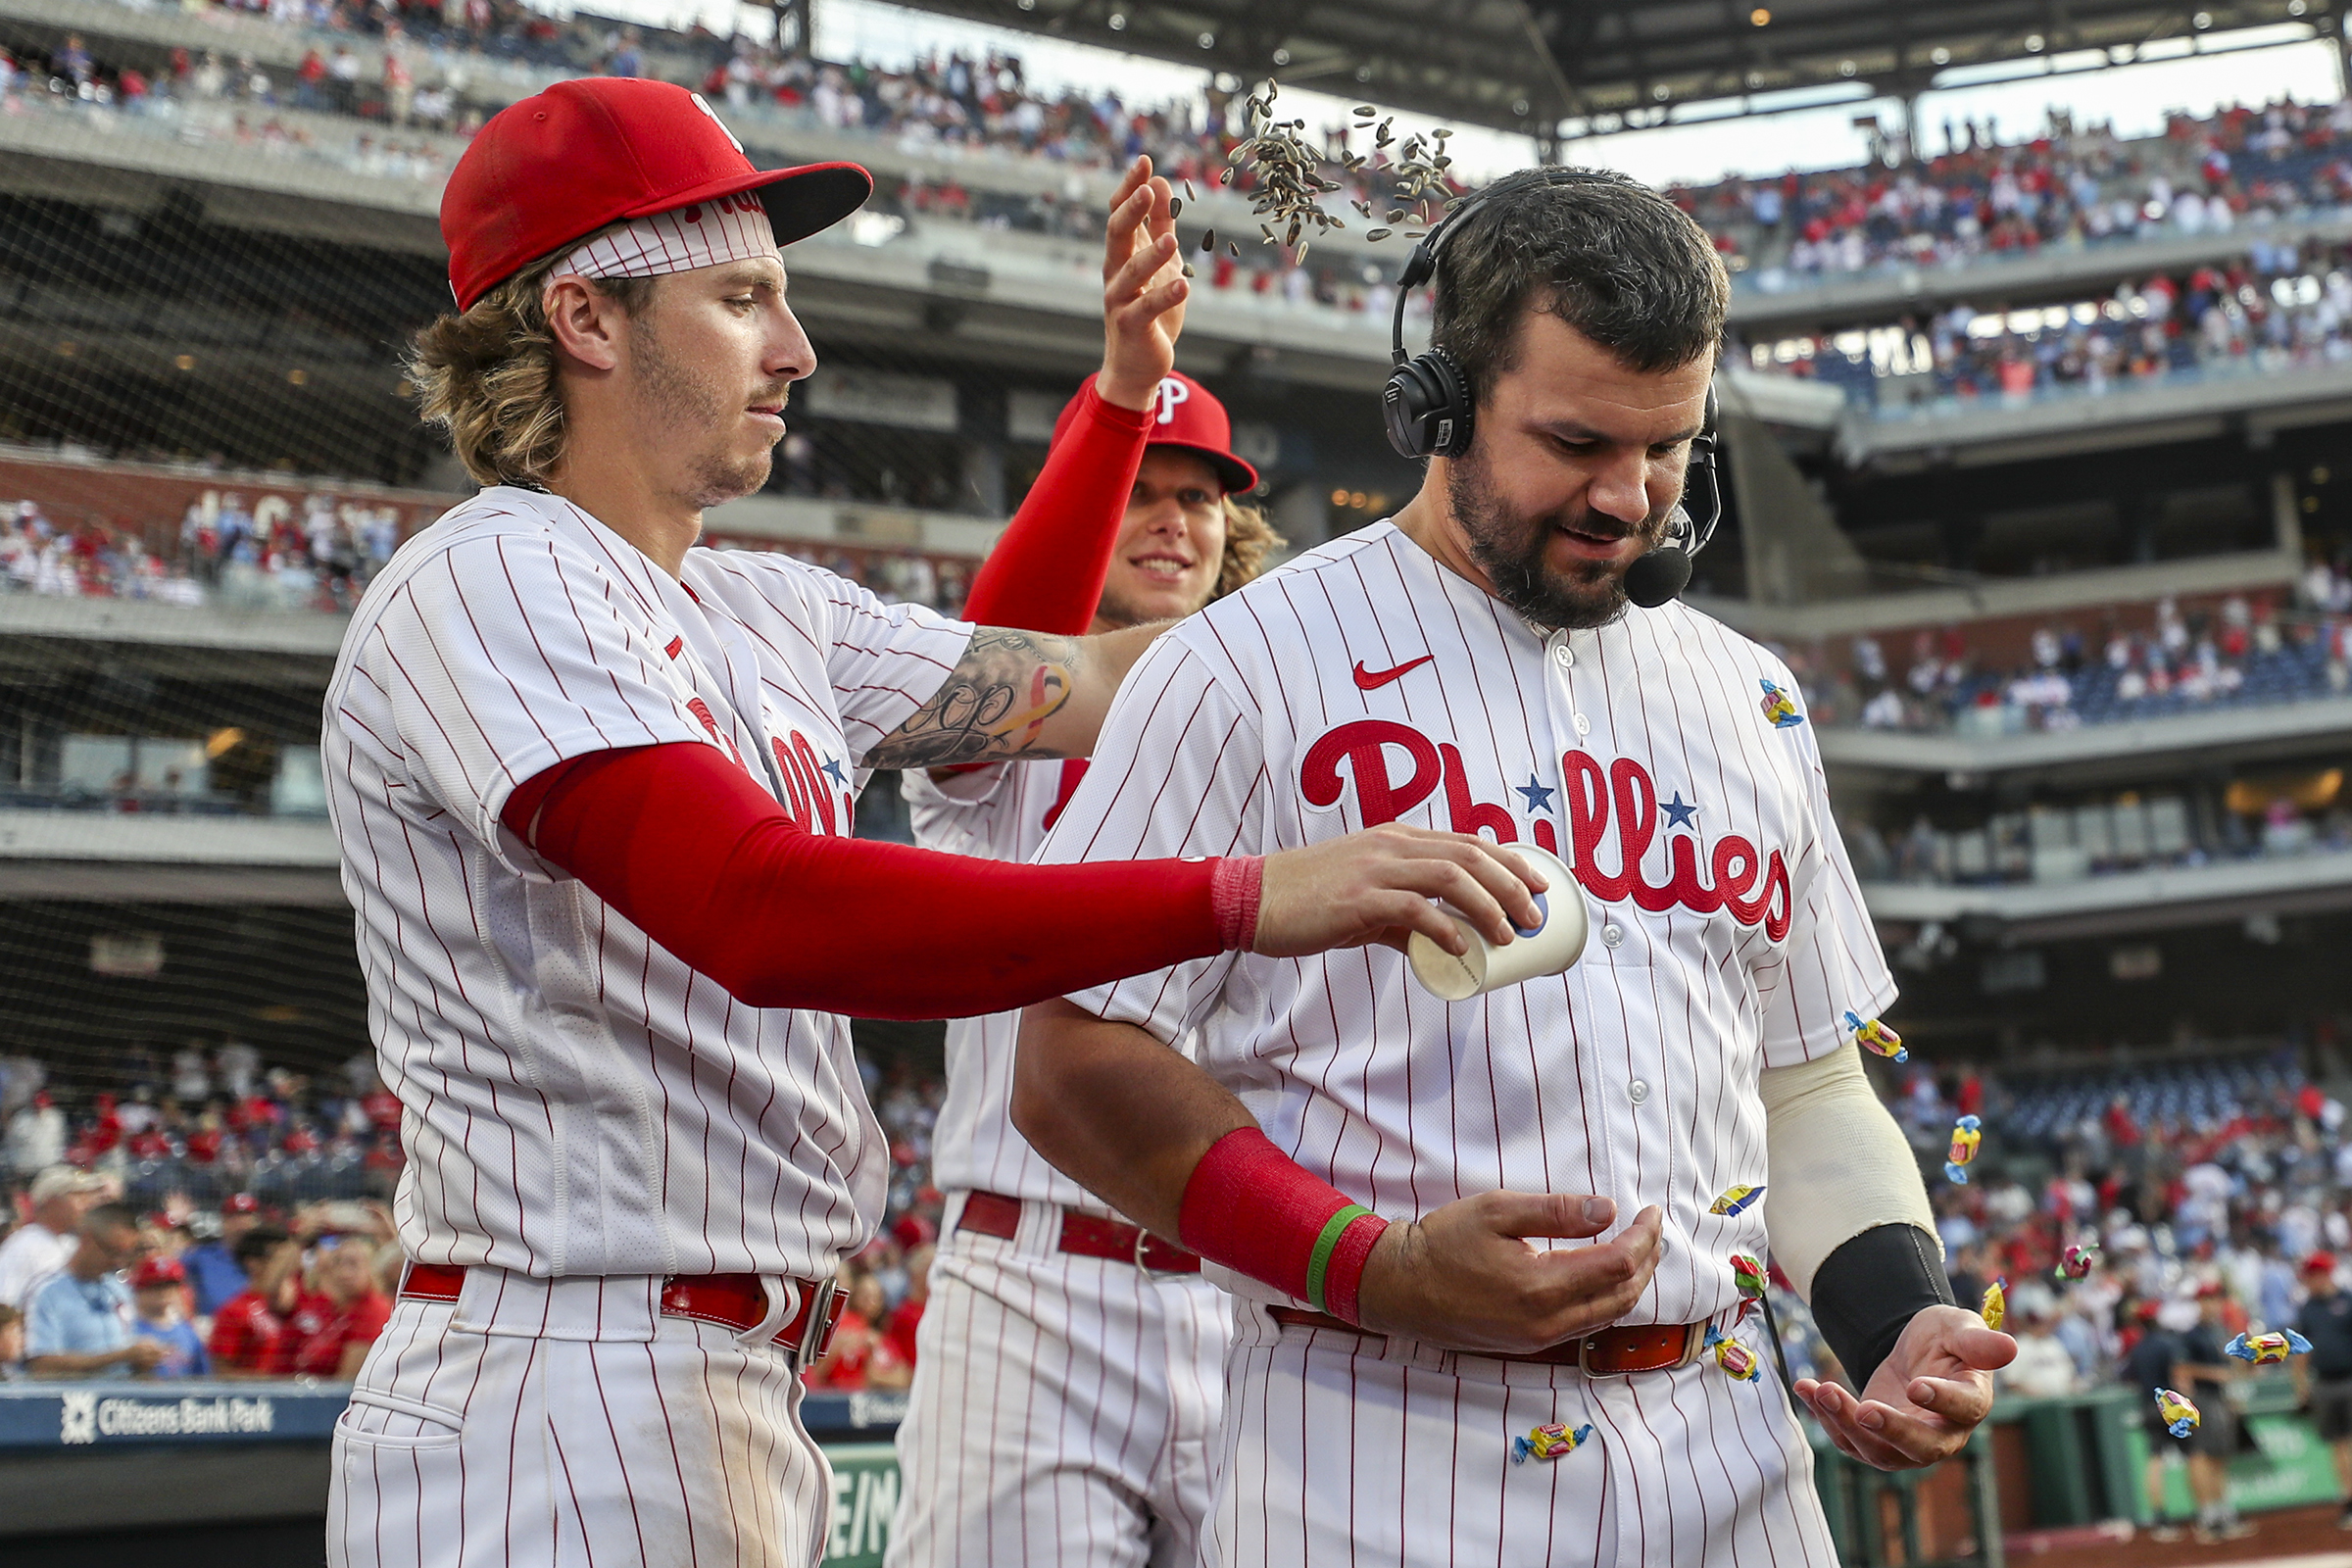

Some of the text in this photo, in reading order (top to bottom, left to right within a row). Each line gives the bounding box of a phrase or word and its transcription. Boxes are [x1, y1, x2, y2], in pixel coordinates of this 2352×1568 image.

[1300, 719, 1791, 942] Phillies
[99, 1396, 274, 1435] Citizens Bank Park
